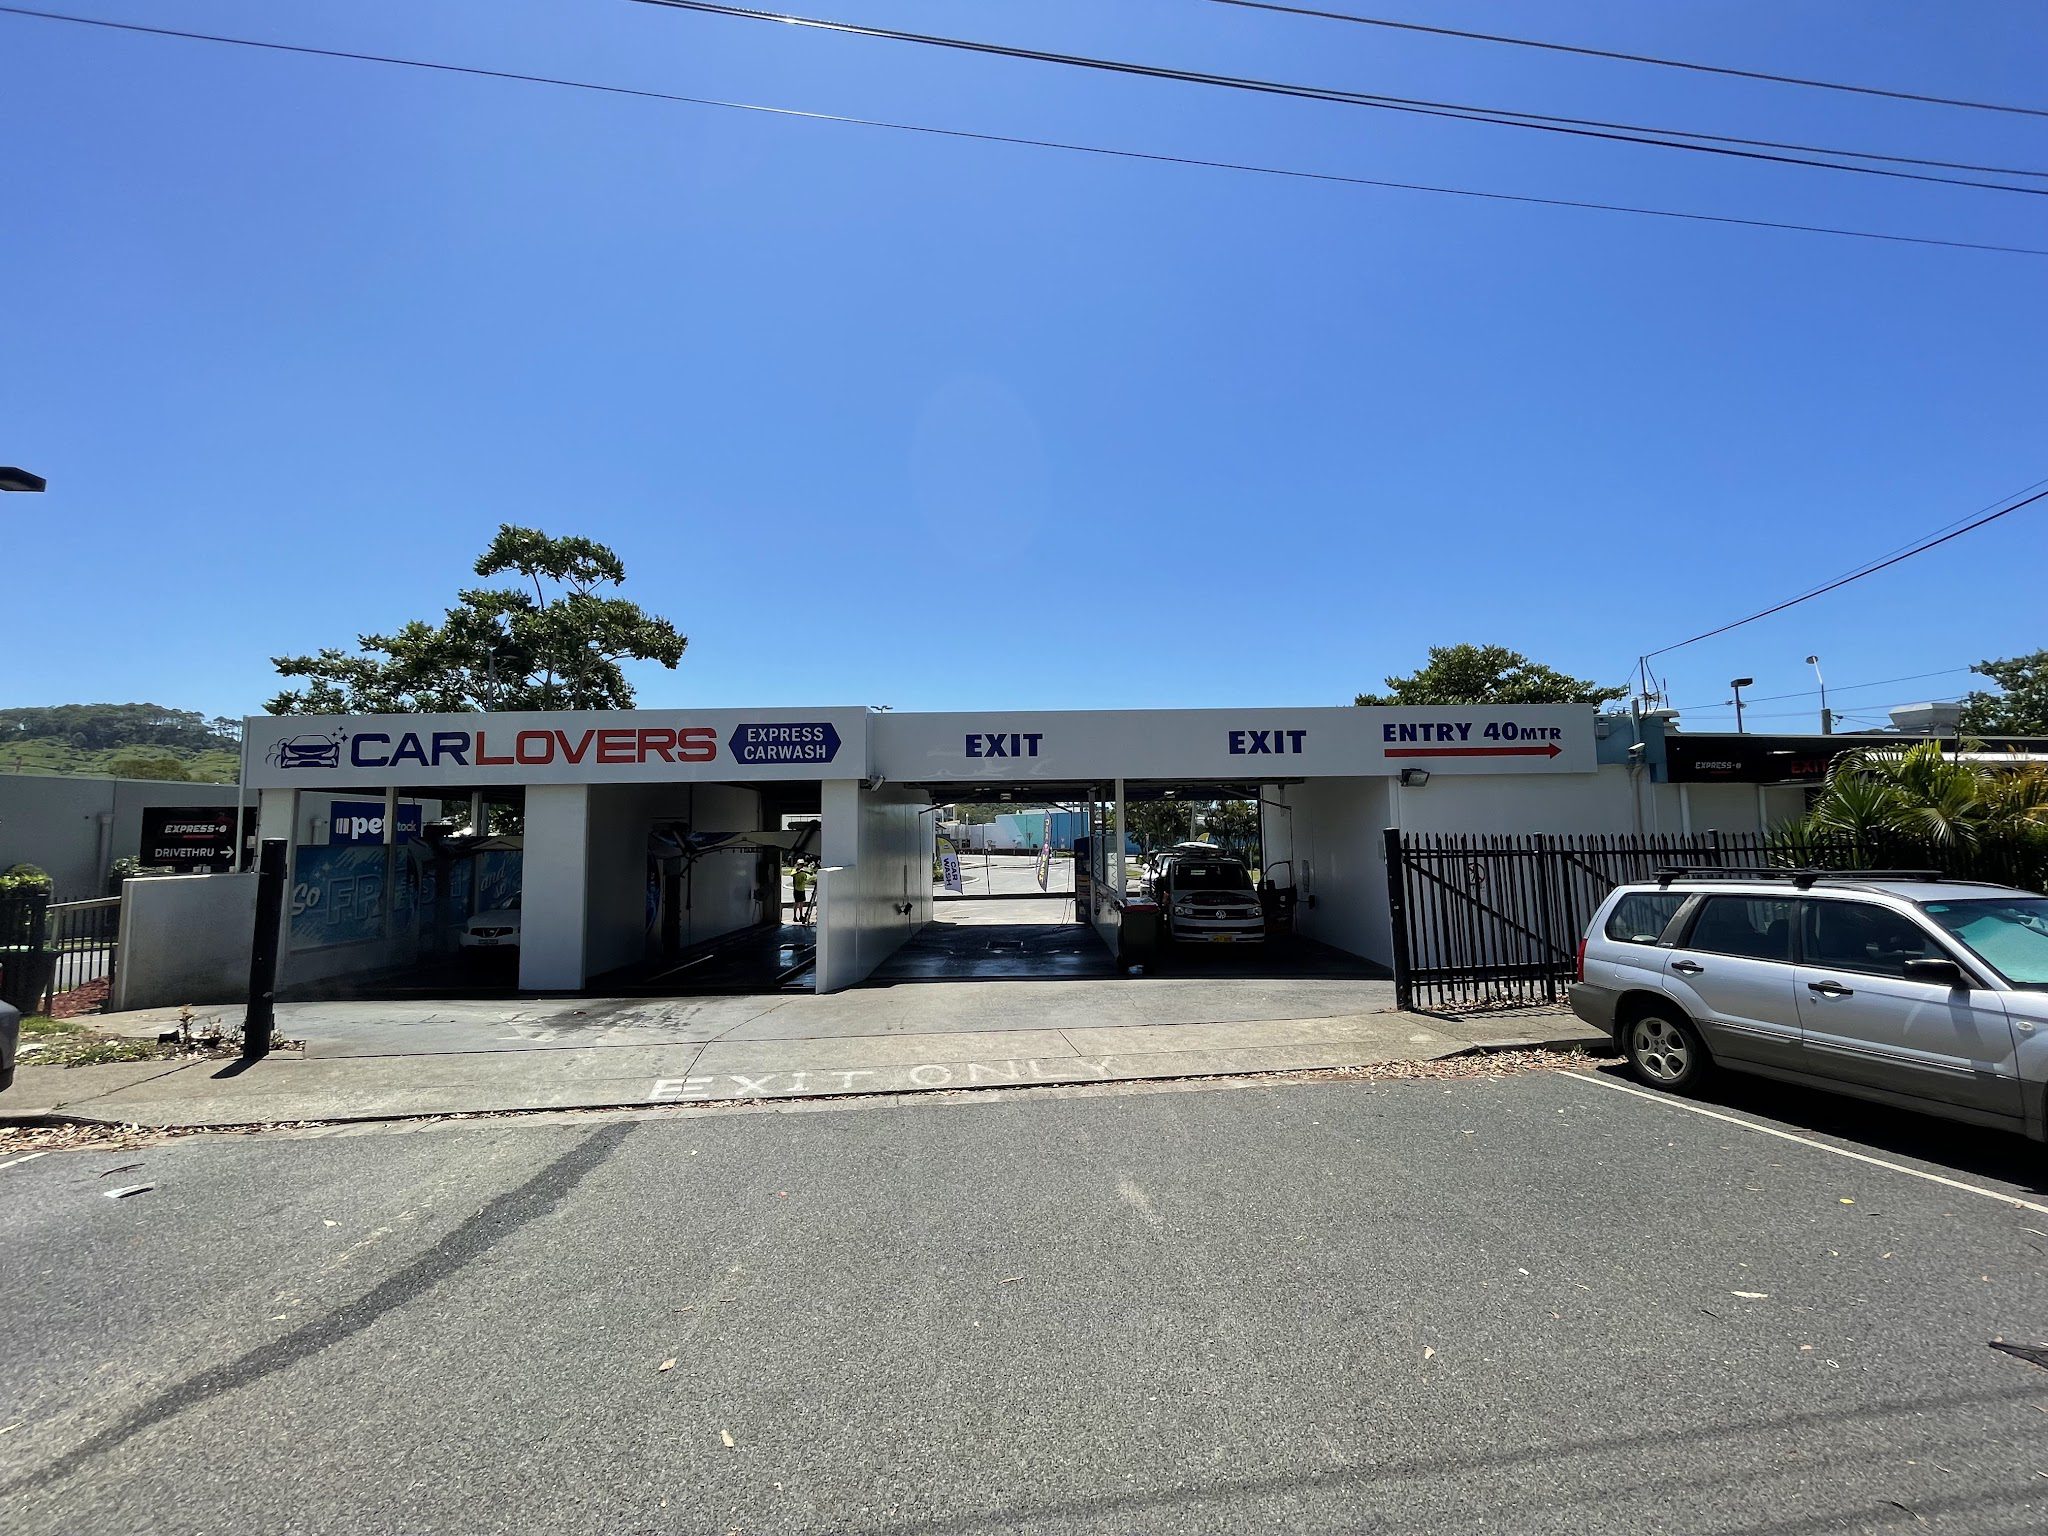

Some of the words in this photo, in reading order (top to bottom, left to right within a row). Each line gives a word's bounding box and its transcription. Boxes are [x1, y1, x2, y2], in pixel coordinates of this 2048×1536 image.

[747, 727, 824, 742] EXPRESS
[1228, 729, 1307, 755] EXIT
[1383, 722, 1473, 743] ENTRY
[350, 727, 717, 767] CARLOVERS
[743, 744, 827, 760] CARWASH
[965, 733, 1043, 758] EXIT
[154, 847, 215, 858] DRIVETHRU
[944, 858, 952, 885] WASH
[950, 861, 958, 881] CAR
[648, 1070, 874, 1100] EXIT
[910, 1056, 1115, 1086] ONLY
